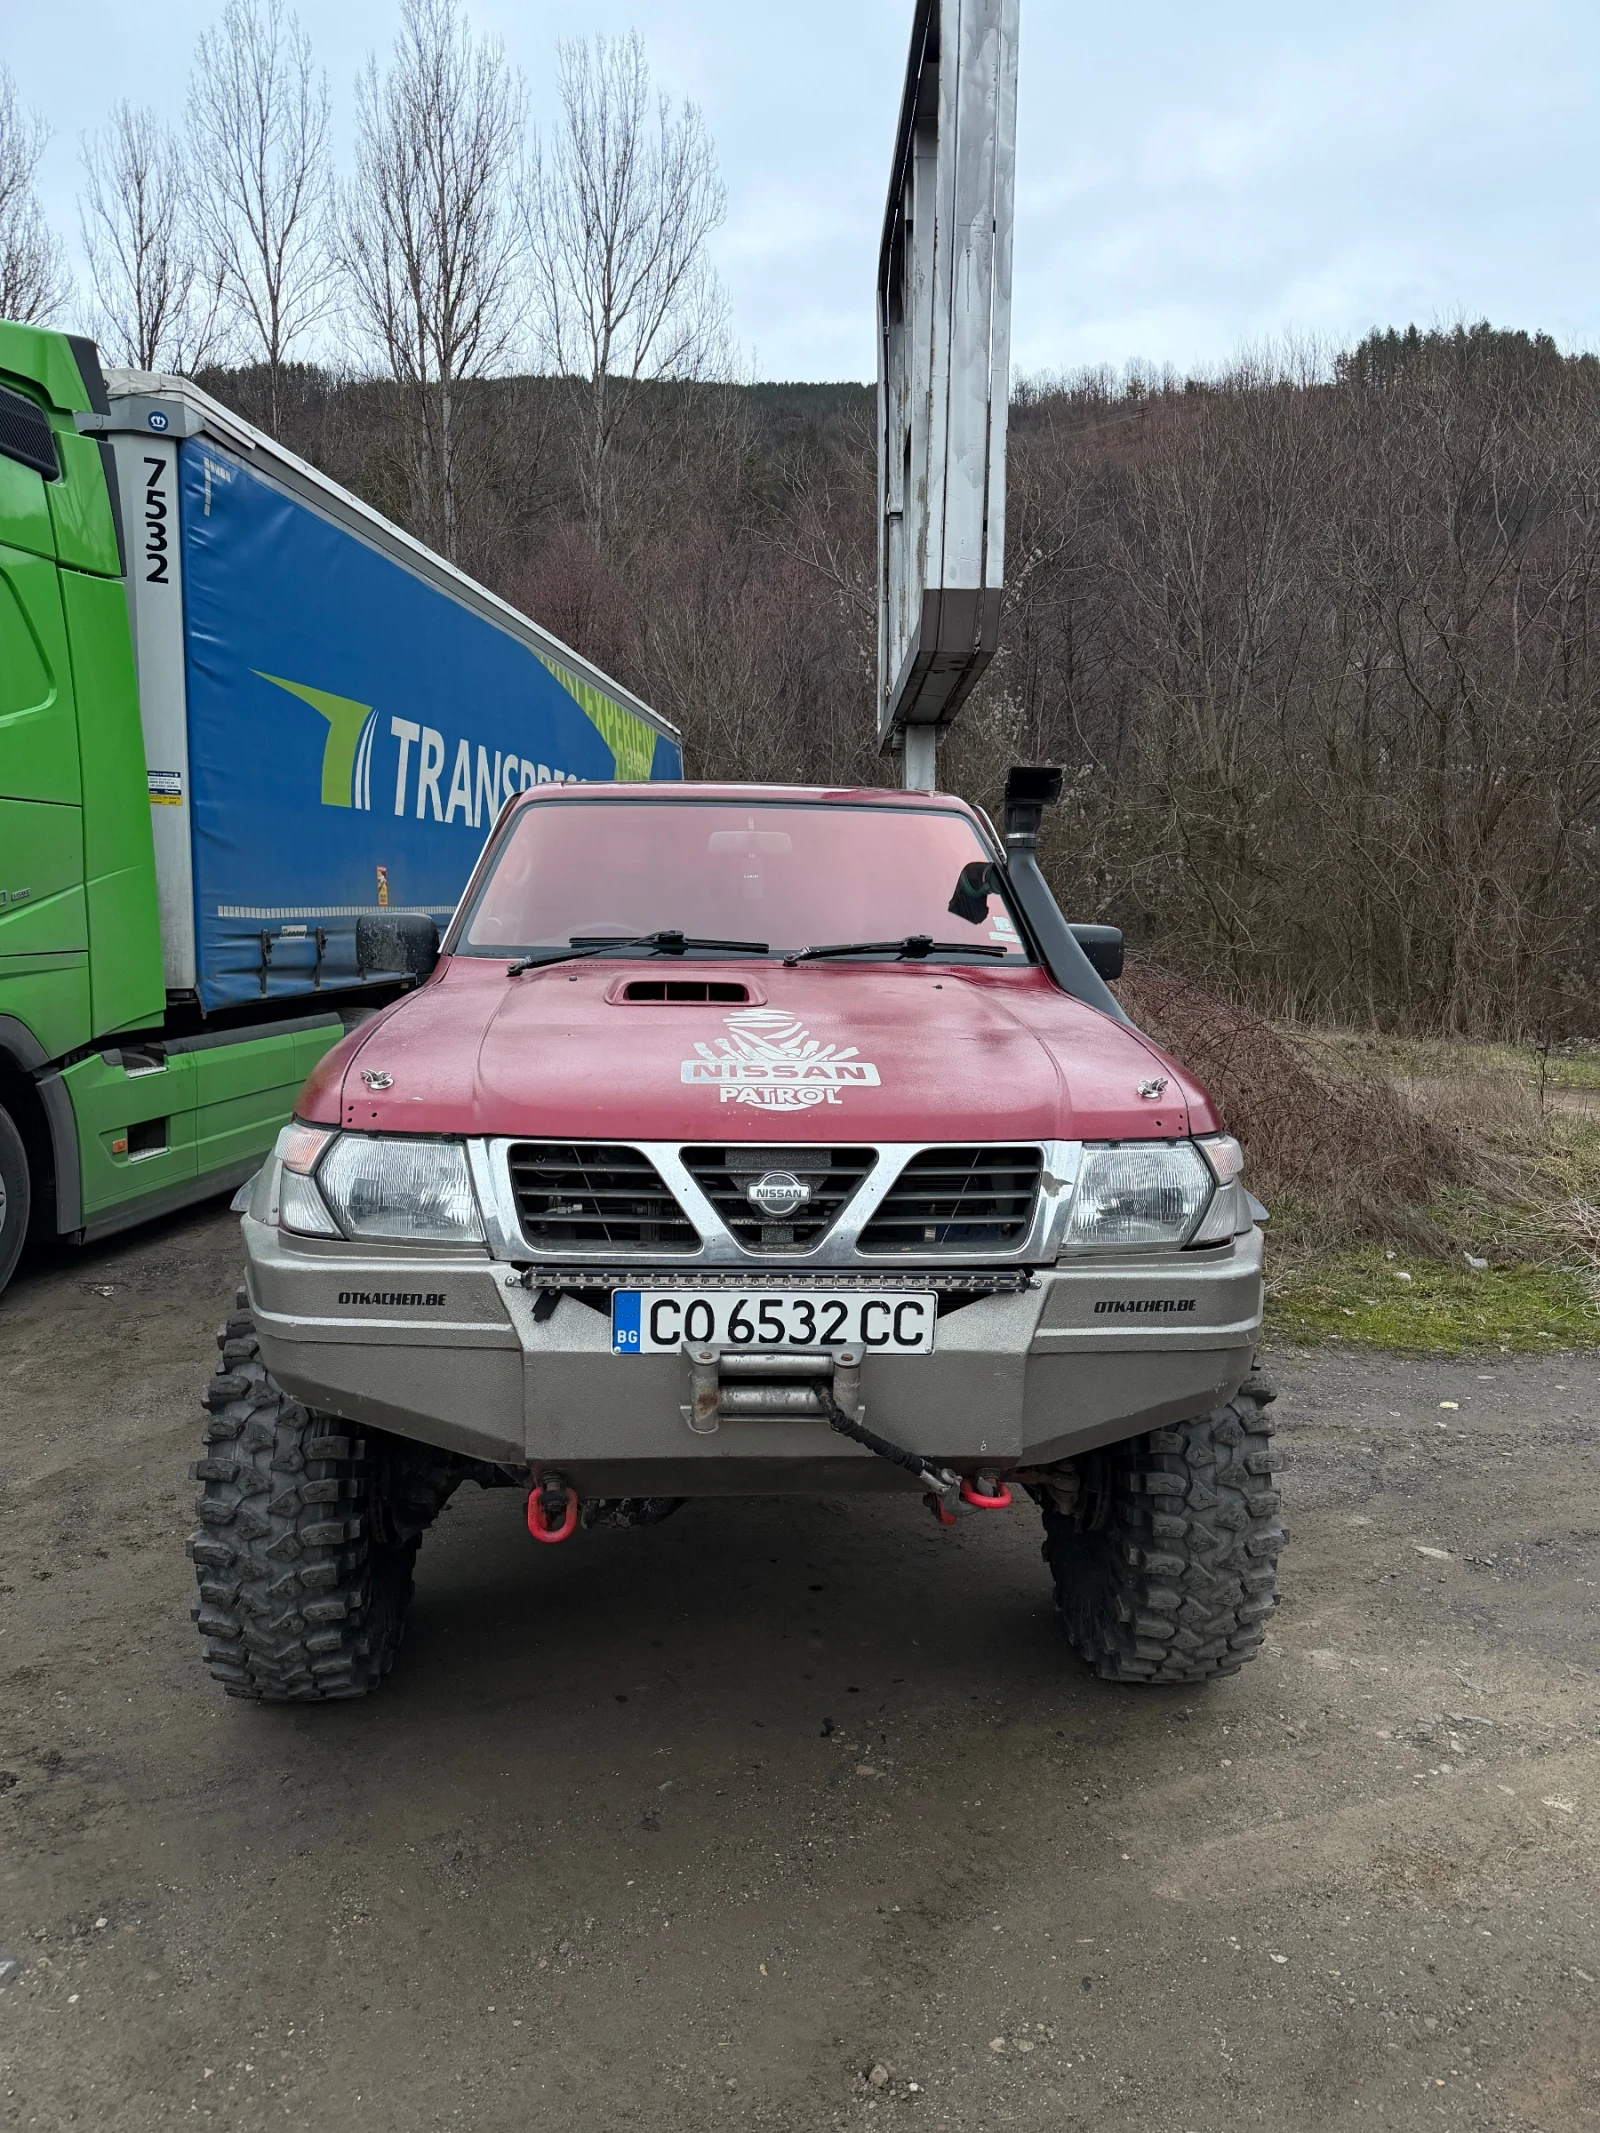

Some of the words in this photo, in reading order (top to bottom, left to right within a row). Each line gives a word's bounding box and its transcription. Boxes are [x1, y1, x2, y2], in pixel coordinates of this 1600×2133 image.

[144, 457, 169, 584] 7532
[391, 716, 588, 829] TRANS
[692, 1063, 866, 1081] NISSAN
[720, 1085, 843, 1105] PATROL
[756, 1188, 803, 1199] NISSAN
[727, 1299, 849, 1345] 6532
[860, 1301, 924, 1346] CC
[617, 1330, 638, 1344] BG
